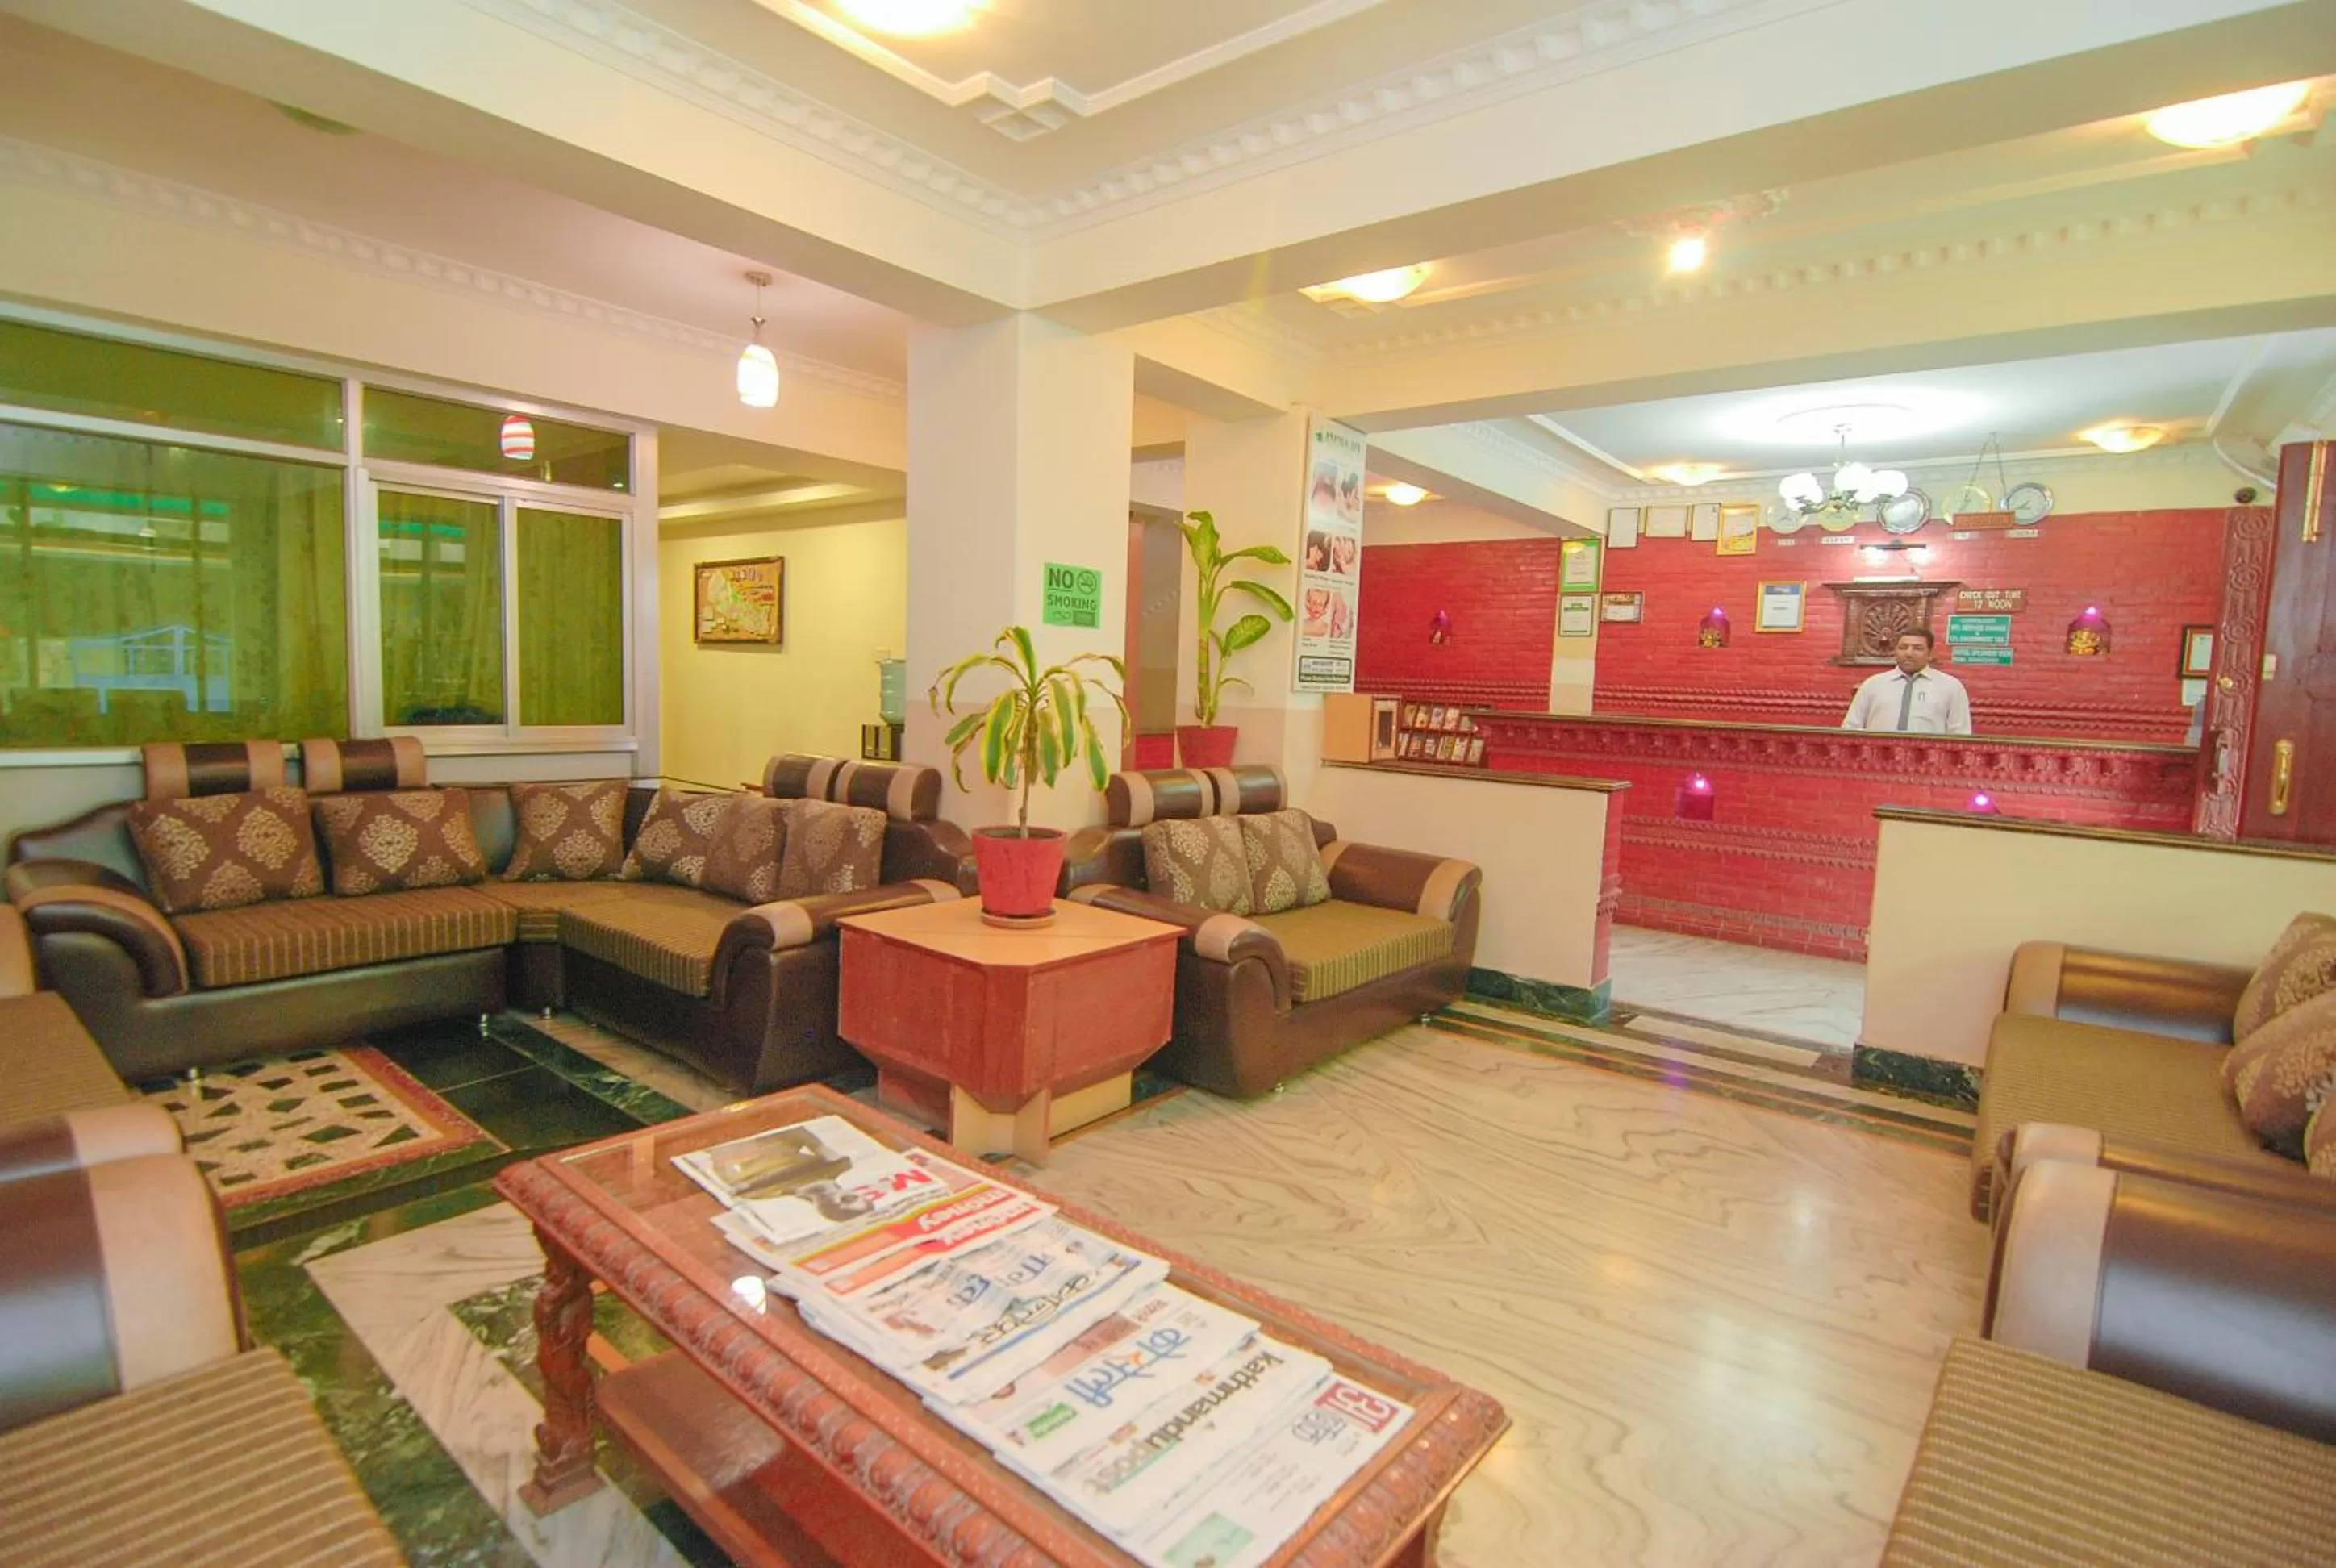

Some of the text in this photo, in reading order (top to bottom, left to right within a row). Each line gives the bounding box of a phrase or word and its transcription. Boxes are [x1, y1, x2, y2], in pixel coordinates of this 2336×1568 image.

[1049, 568, 1074, 589] NO
[1047, 594, 1097, 611] SMOKING
[1988, 599, 2012, 609] NOON
[1145, 1351, 1284, 1449] kathmandu
